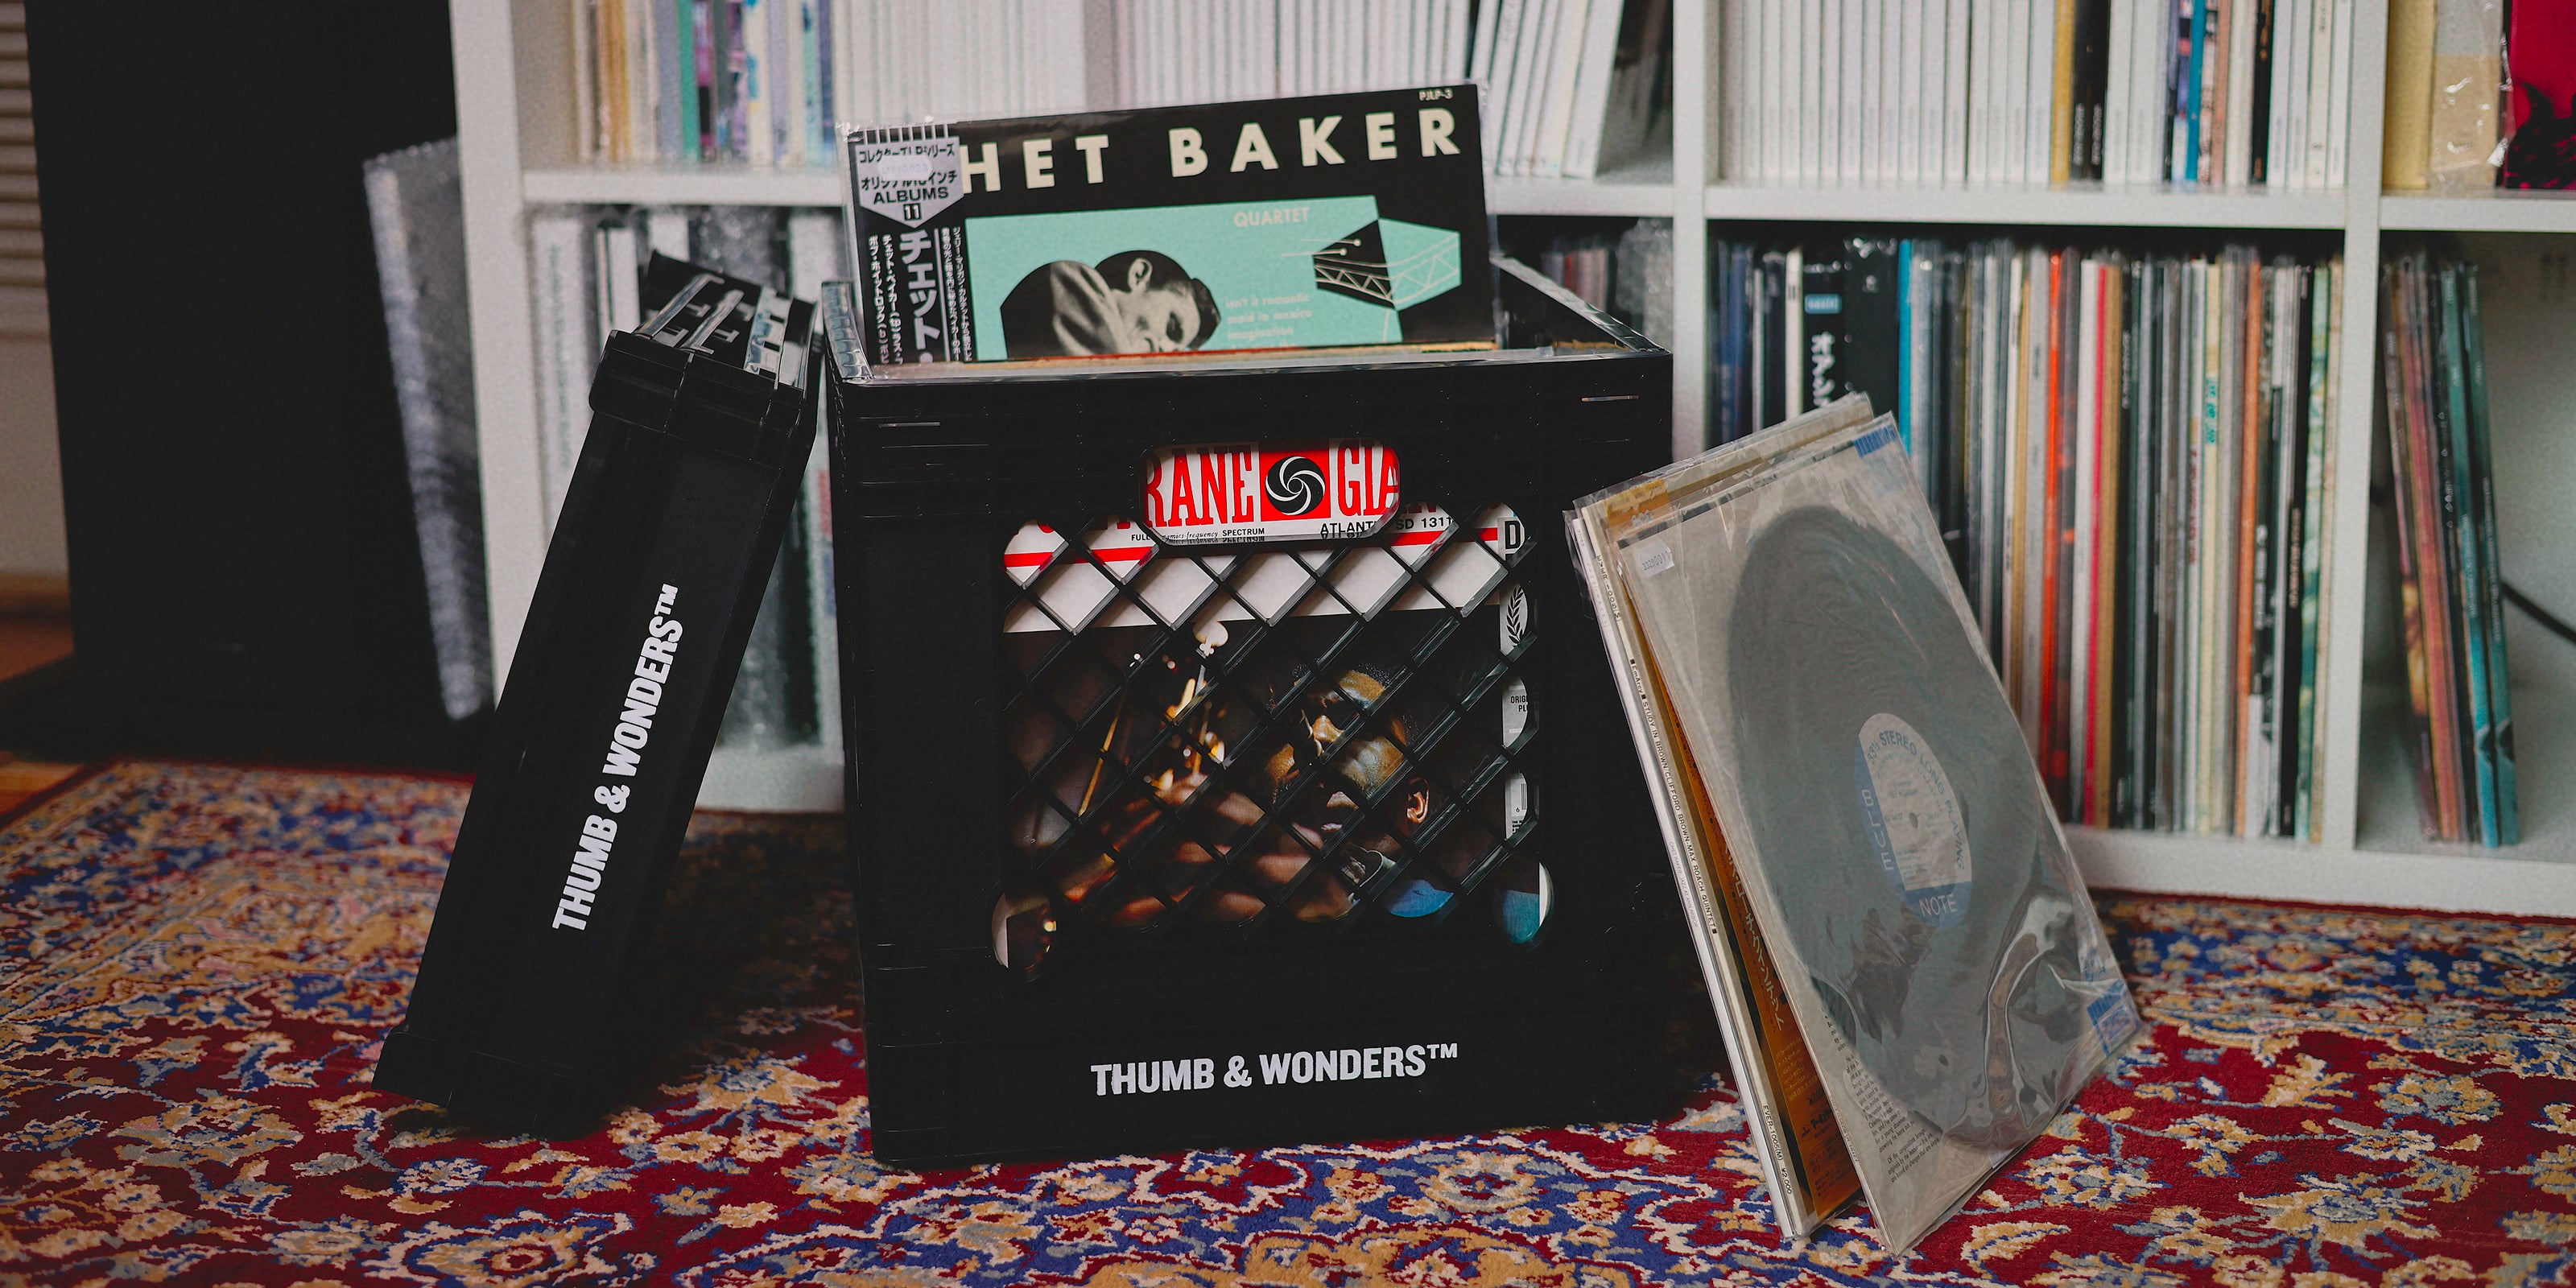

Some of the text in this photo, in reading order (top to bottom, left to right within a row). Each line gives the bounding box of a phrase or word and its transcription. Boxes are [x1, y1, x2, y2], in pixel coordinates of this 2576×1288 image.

[1419, 88, 1453, 101] PJLP-3
[1168, 107, 1460, 178] BAKER
[873, 186, 949, 204] ALBUMS
[904, 204, 920, 221] 11
[1233, 207, 1310, 228] QUARTET
[1262, 292, 1310, 306] romantic
[1228, 326, 1294, 341] imagination
[1222, 527, 1265, 538] SPECTRUM
[1320, 520, 1377, 535] ATLANT
[1395, 519, 1414, 530] SD
[1518, 704, 1527, 712] PL
[1879, 730, 1918, 755] STEREO
[1642, 700, 1656, 728] STUDY
[1652, 728, 1659, 739] IN
[1693, 864, 1705, 893] ROACH
[1702, 893, 1716, 928] QUINTET
[1920, 753, 1945, 795] LONG
[1945, 799, 1966, 871] PLAYING
[1861, 789, 1894, 870] BLUE
[552, 814, 618, 931] THUMB
[594, 784, 630, 813] &
[1919, 894, 1959, 917] NOTE
[1091, 1058, 1214, 1096] THUMB
[1223, 1055, 1253, 1088] &
[1763, 1104, 1784, 1162] EVER-1005(M)
